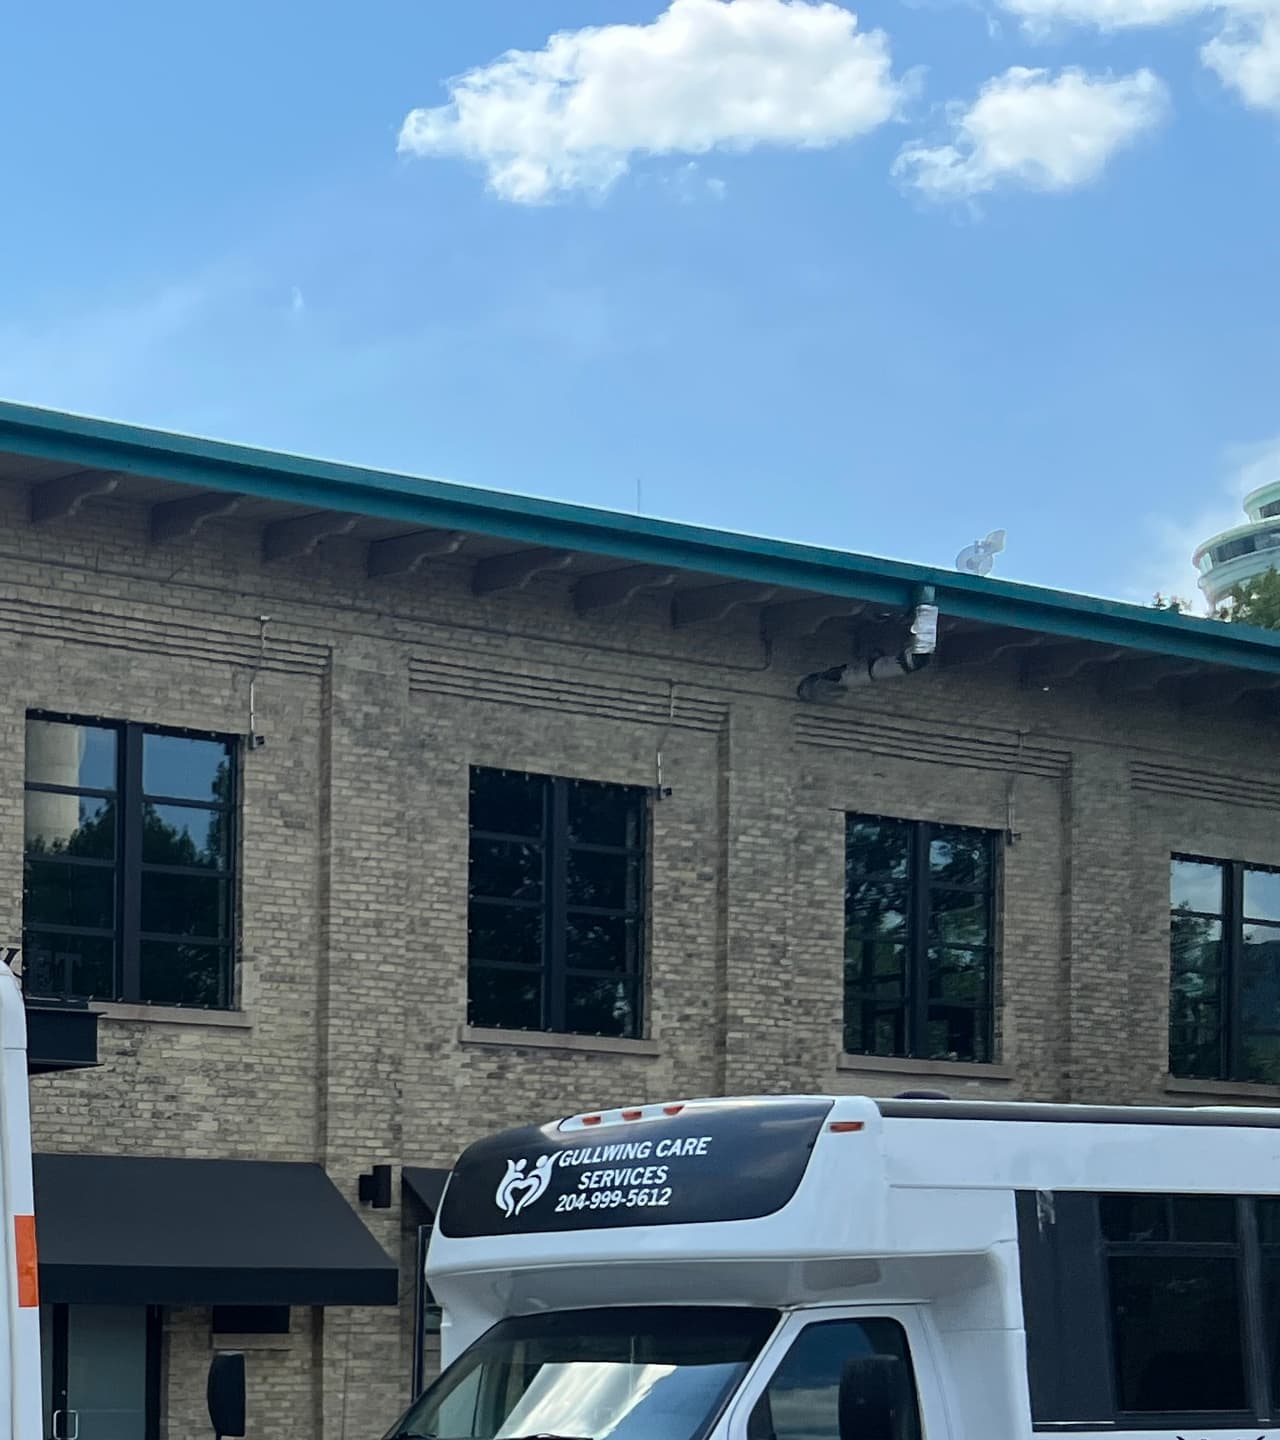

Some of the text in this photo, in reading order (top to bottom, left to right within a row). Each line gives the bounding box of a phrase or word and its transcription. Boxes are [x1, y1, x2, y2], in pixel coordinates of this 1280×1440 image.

[558, 1136, 713, 1168] GULLWING CARE
[578, 1165, 669, 1190] SERVICES
[554, 1186, 673, 1213] 204-999-5612
